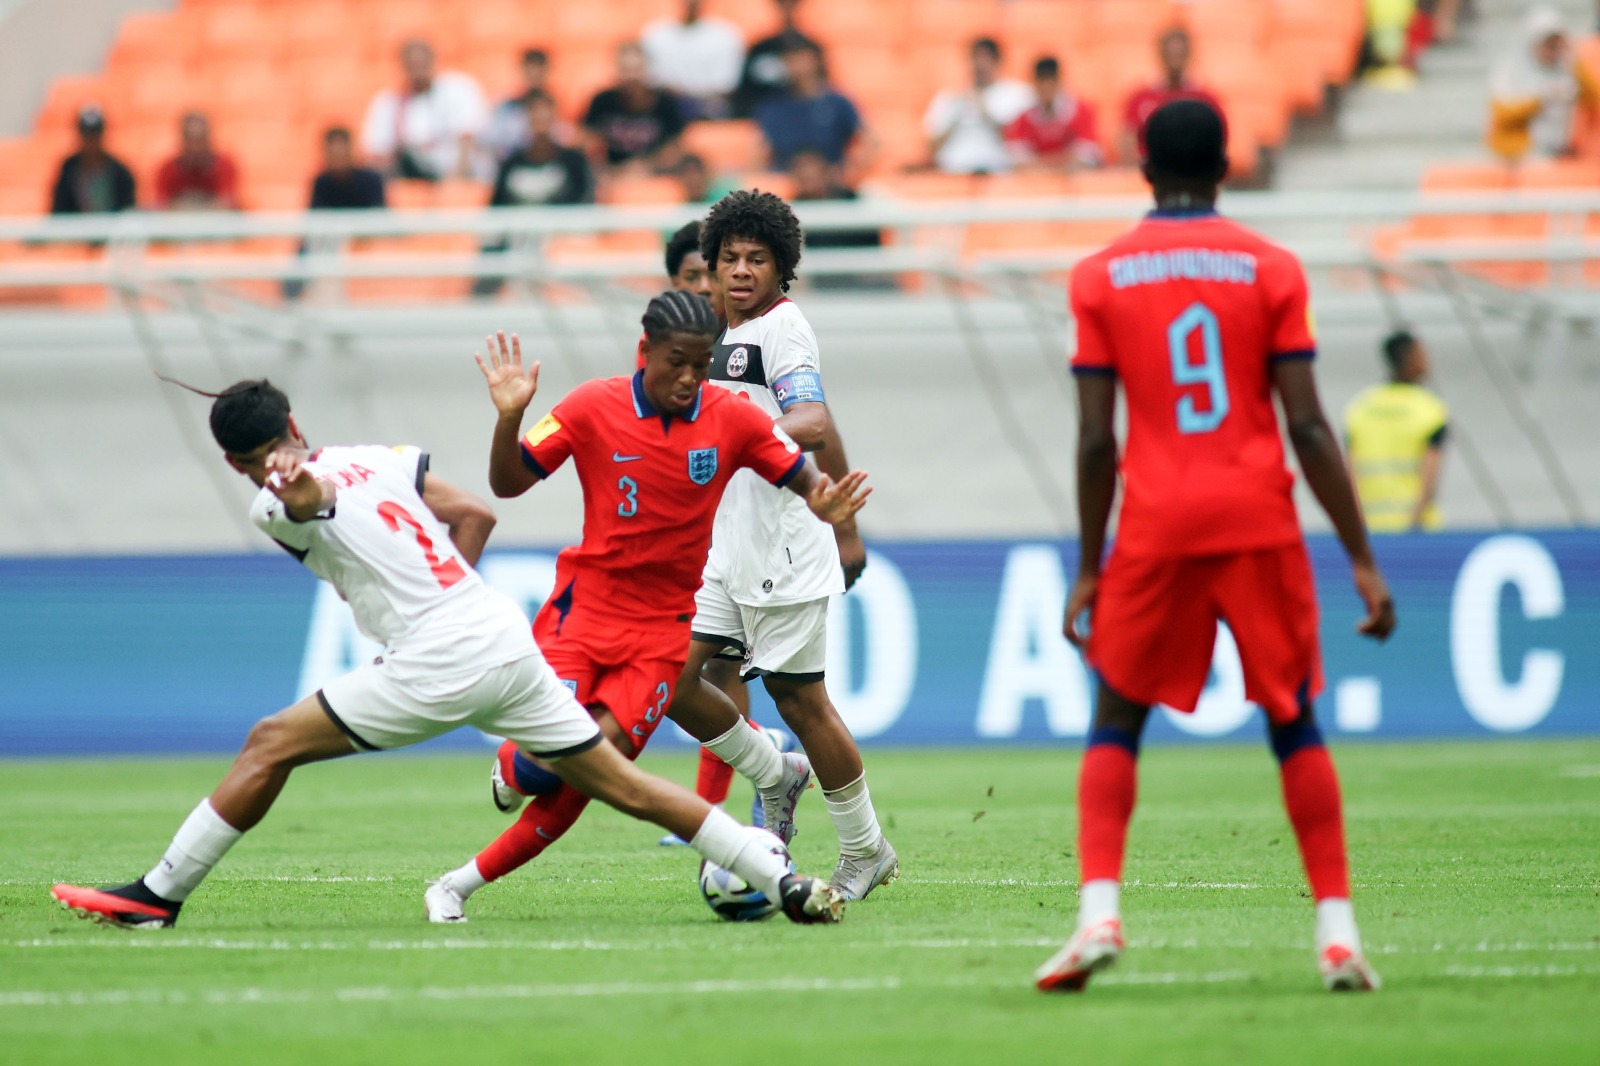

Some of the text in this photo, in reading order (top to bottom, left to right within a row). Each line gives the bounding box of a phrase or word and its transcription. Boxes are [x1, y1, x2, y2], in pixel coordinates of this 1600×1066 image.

[793, 380, 817, 388] UNITES
[1168, 302, 1231, 435] 9
[617, 475, 638, 518] 3
[376, 500, 468, 591] 2
[644, 680, 669, 723] 3
